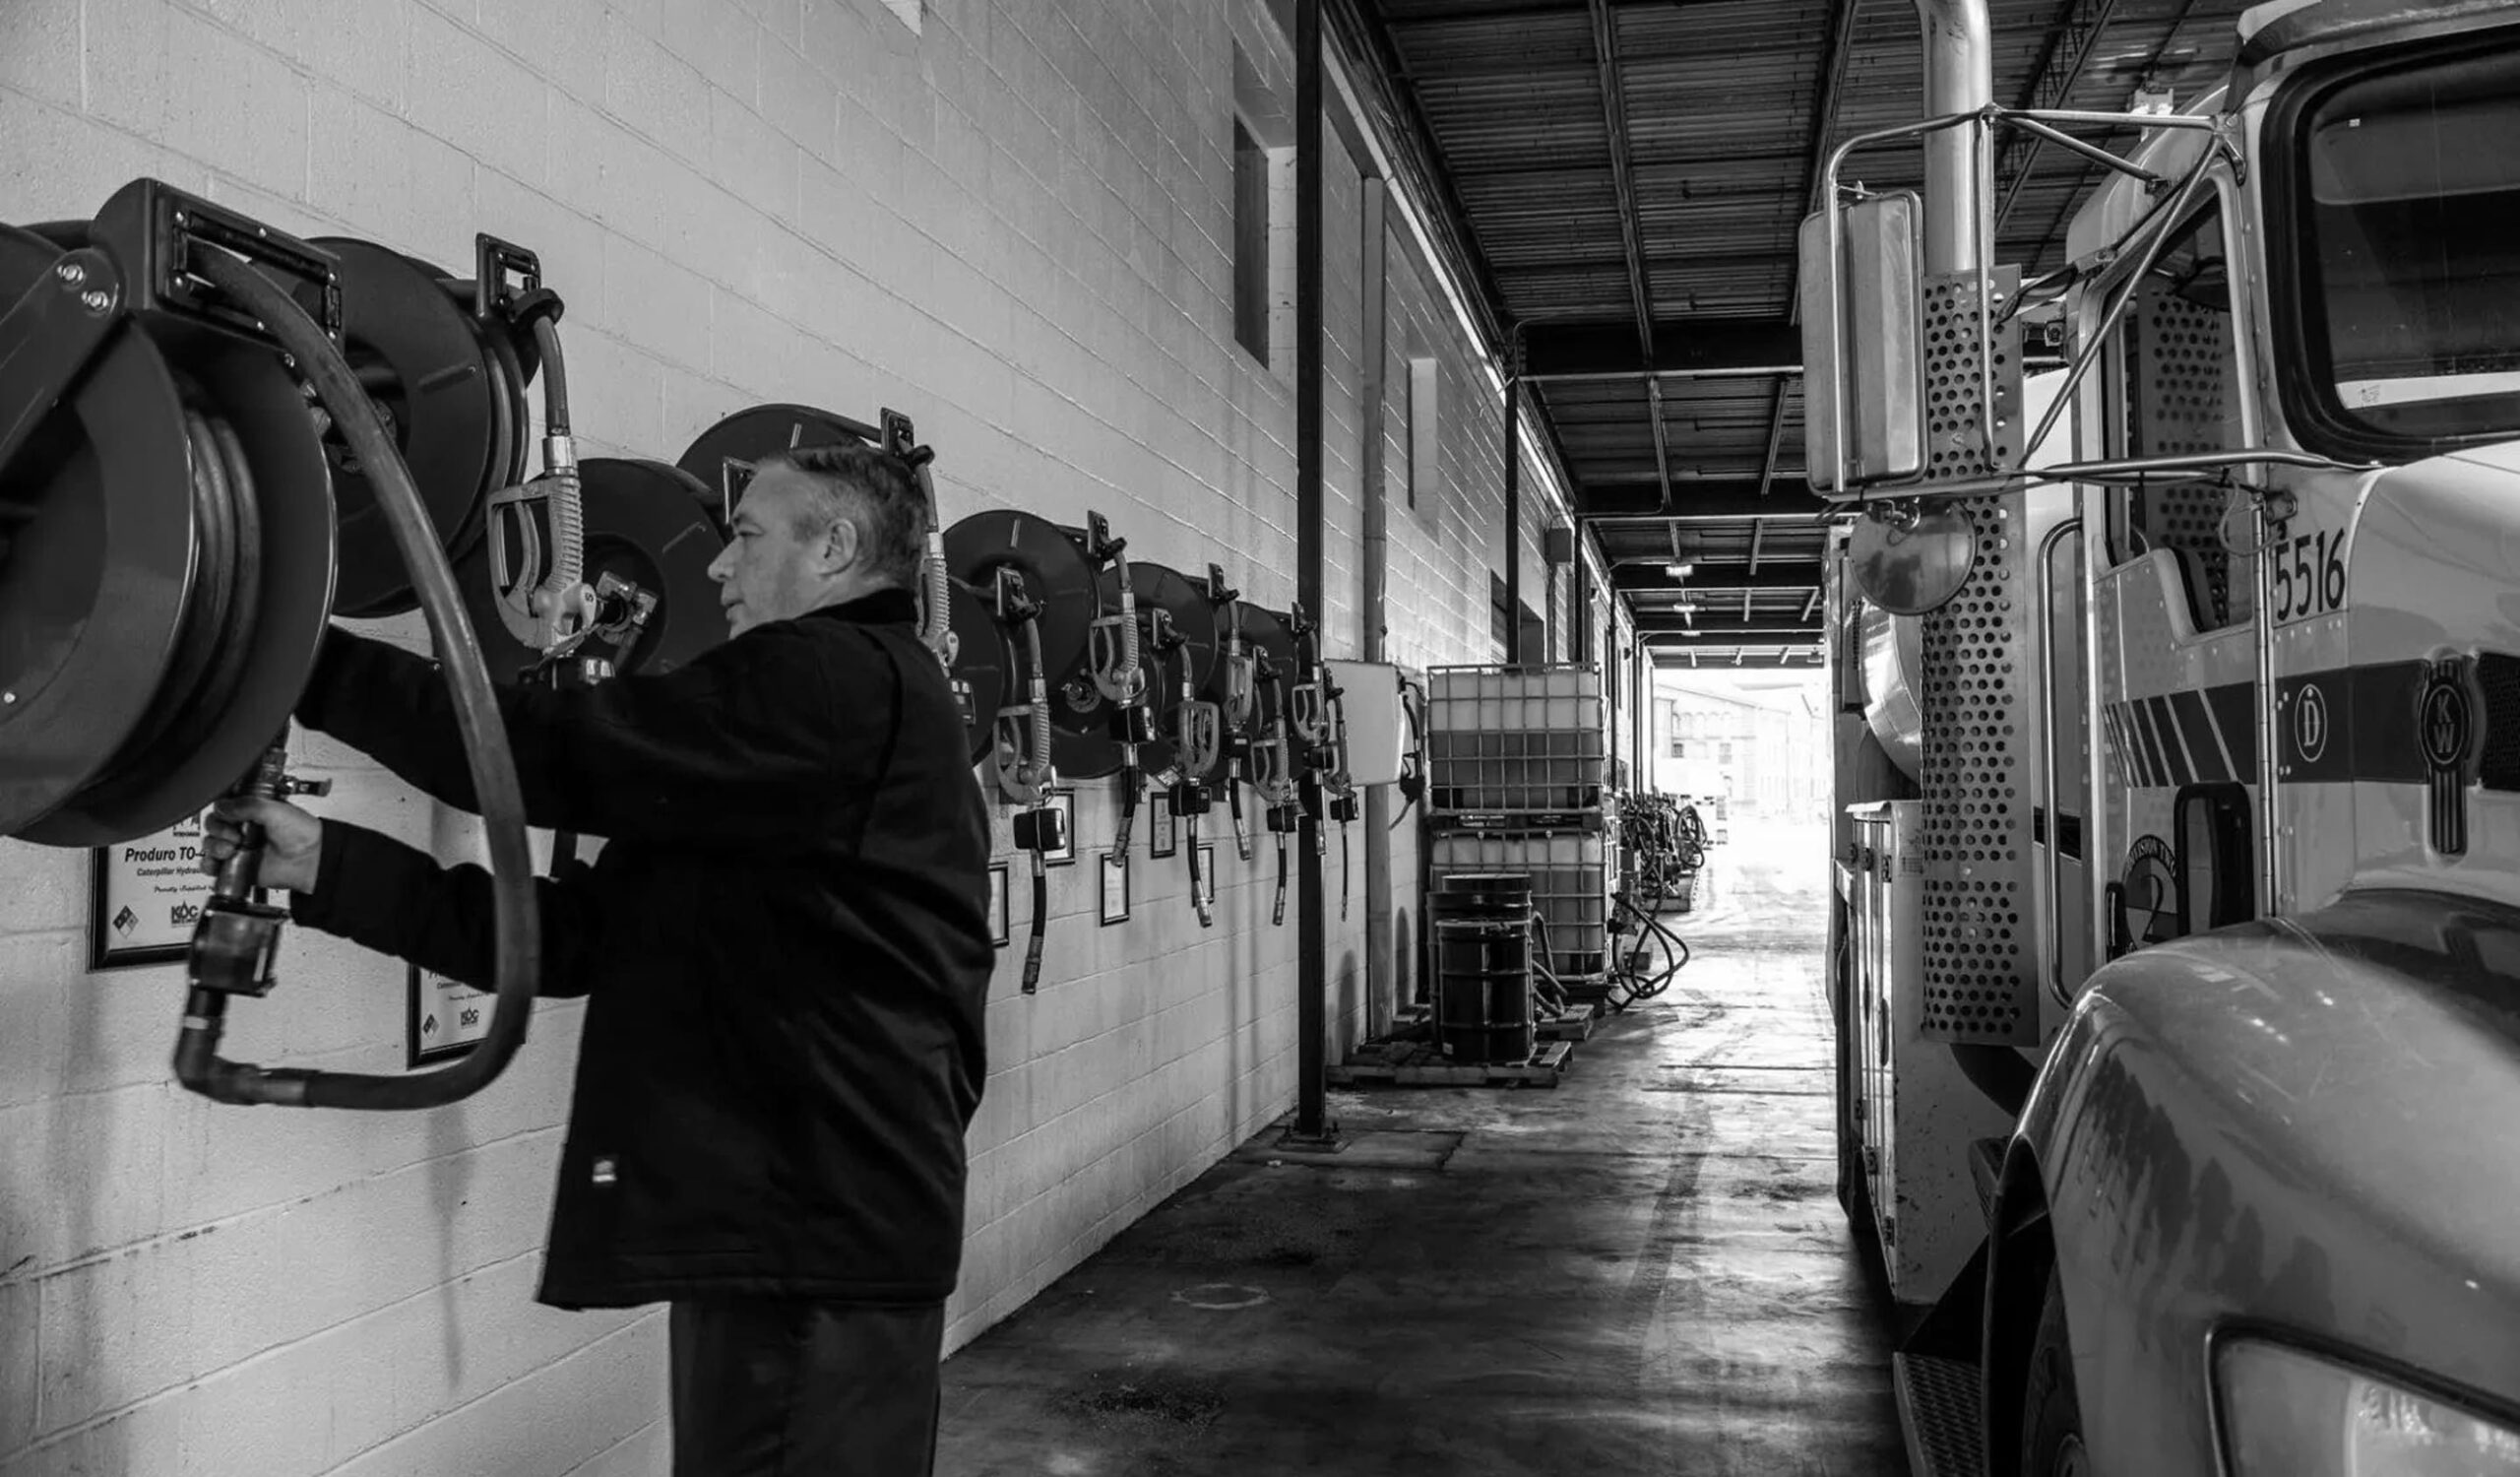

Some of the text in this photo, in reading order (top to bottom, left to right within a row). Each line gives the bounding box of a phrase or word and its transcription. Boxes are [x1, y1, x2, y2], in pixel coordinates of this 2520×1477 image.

[2275, 528, 2346, 621] 5516
[125, 847, 206, 863] Produro TO-
[137, 868, 174, 877] Caterpillar
